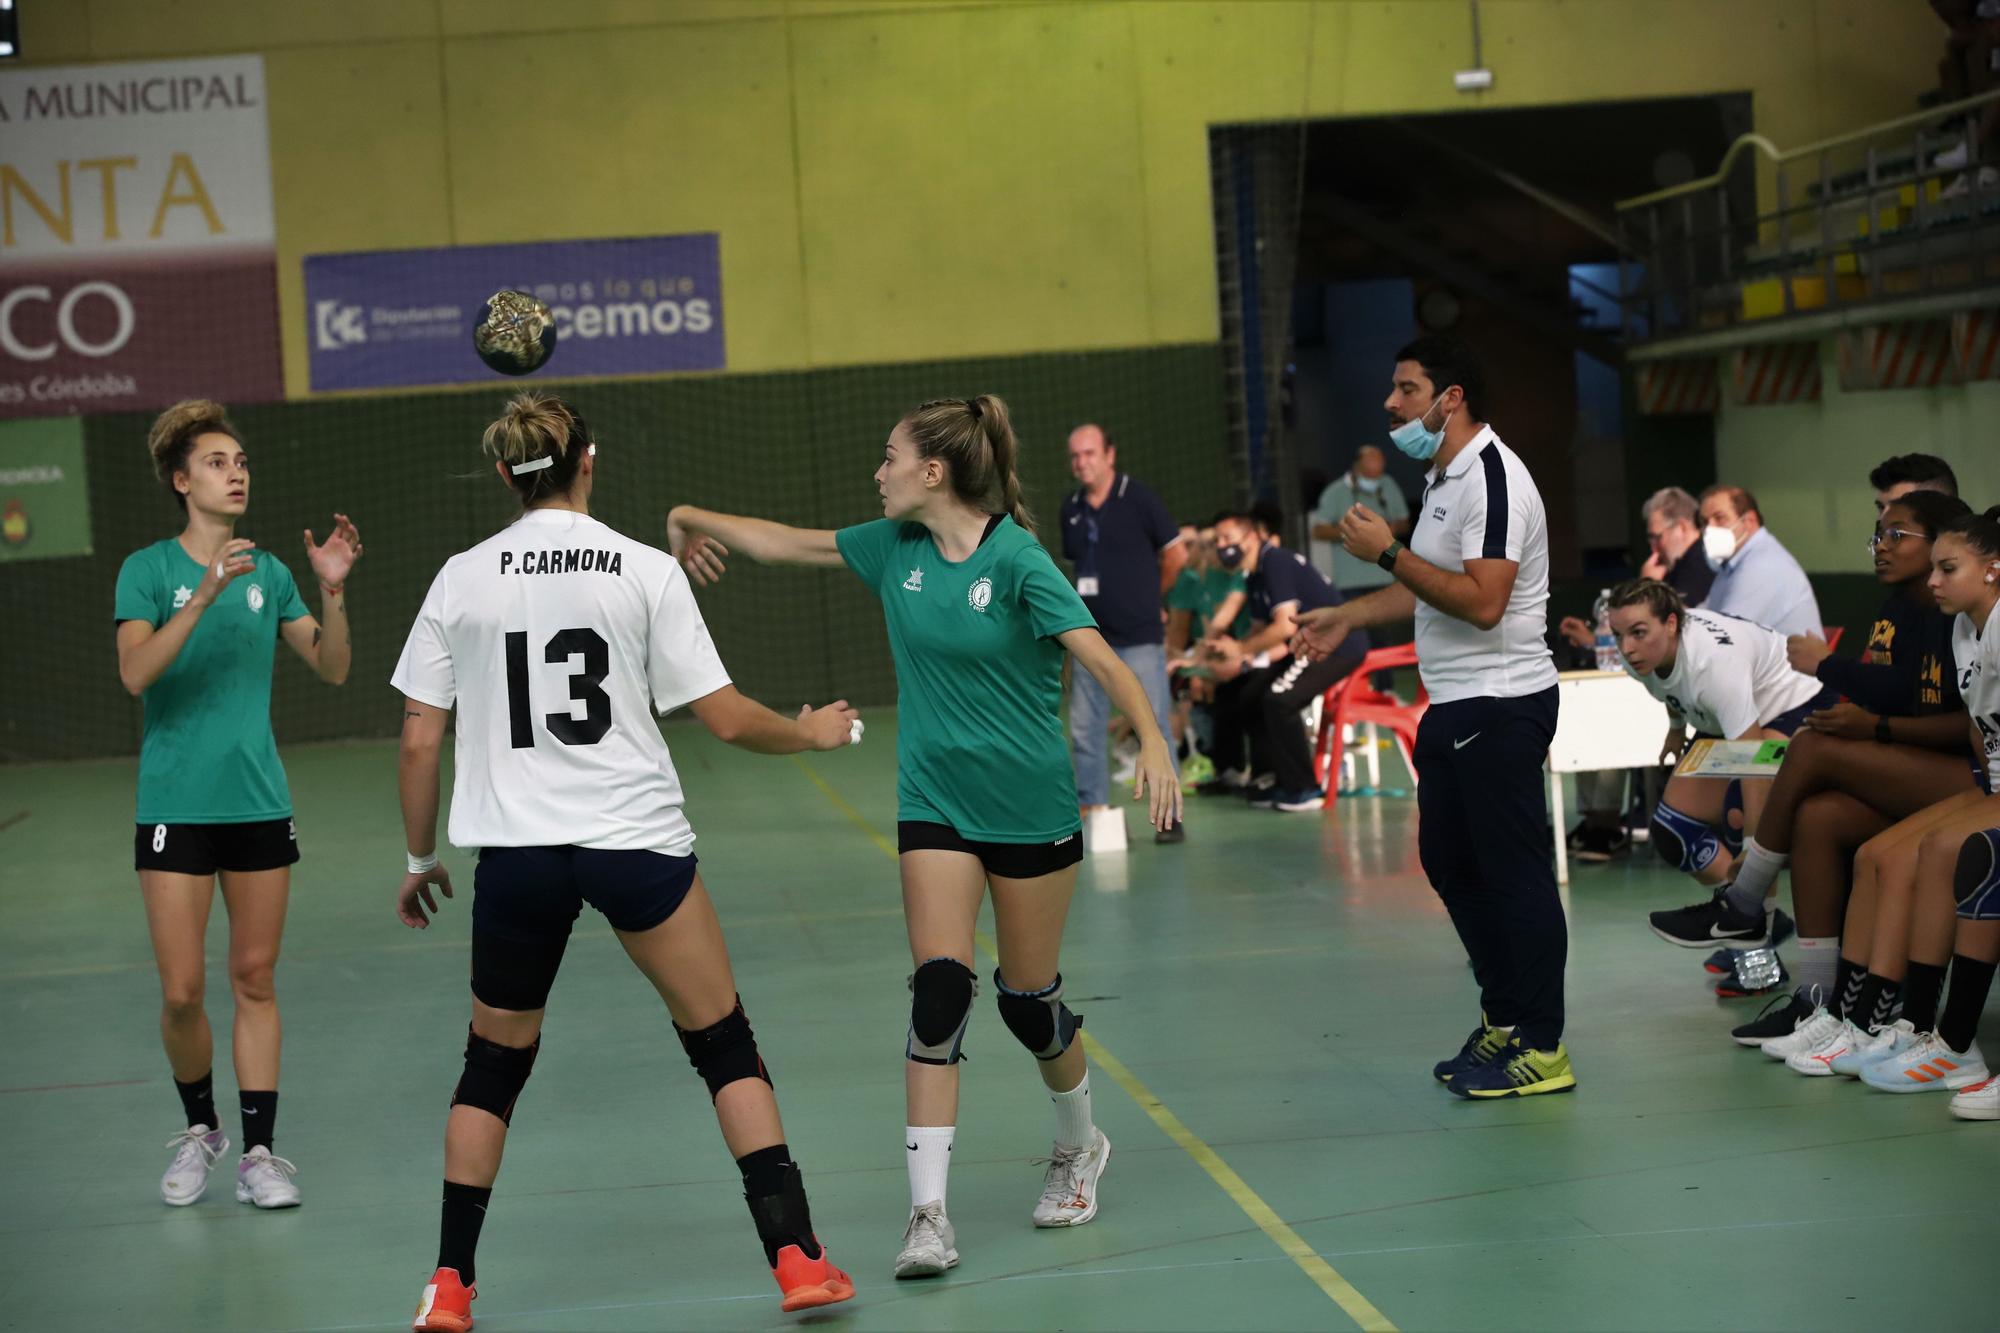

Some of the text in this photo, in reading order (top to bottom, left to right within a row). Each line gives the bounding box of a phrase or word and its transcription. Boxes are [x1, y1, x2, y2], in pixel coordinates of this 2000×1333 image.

[24, 75, 256, 121] MUNICIPAL
[0, 153, 226, 246] NTA
[640, 277, 694, 300] que
[500, 549, 622, 576] P.CARMONA
[505, 627, 613, 750] 13
[152, 823, 168, 853] 8
